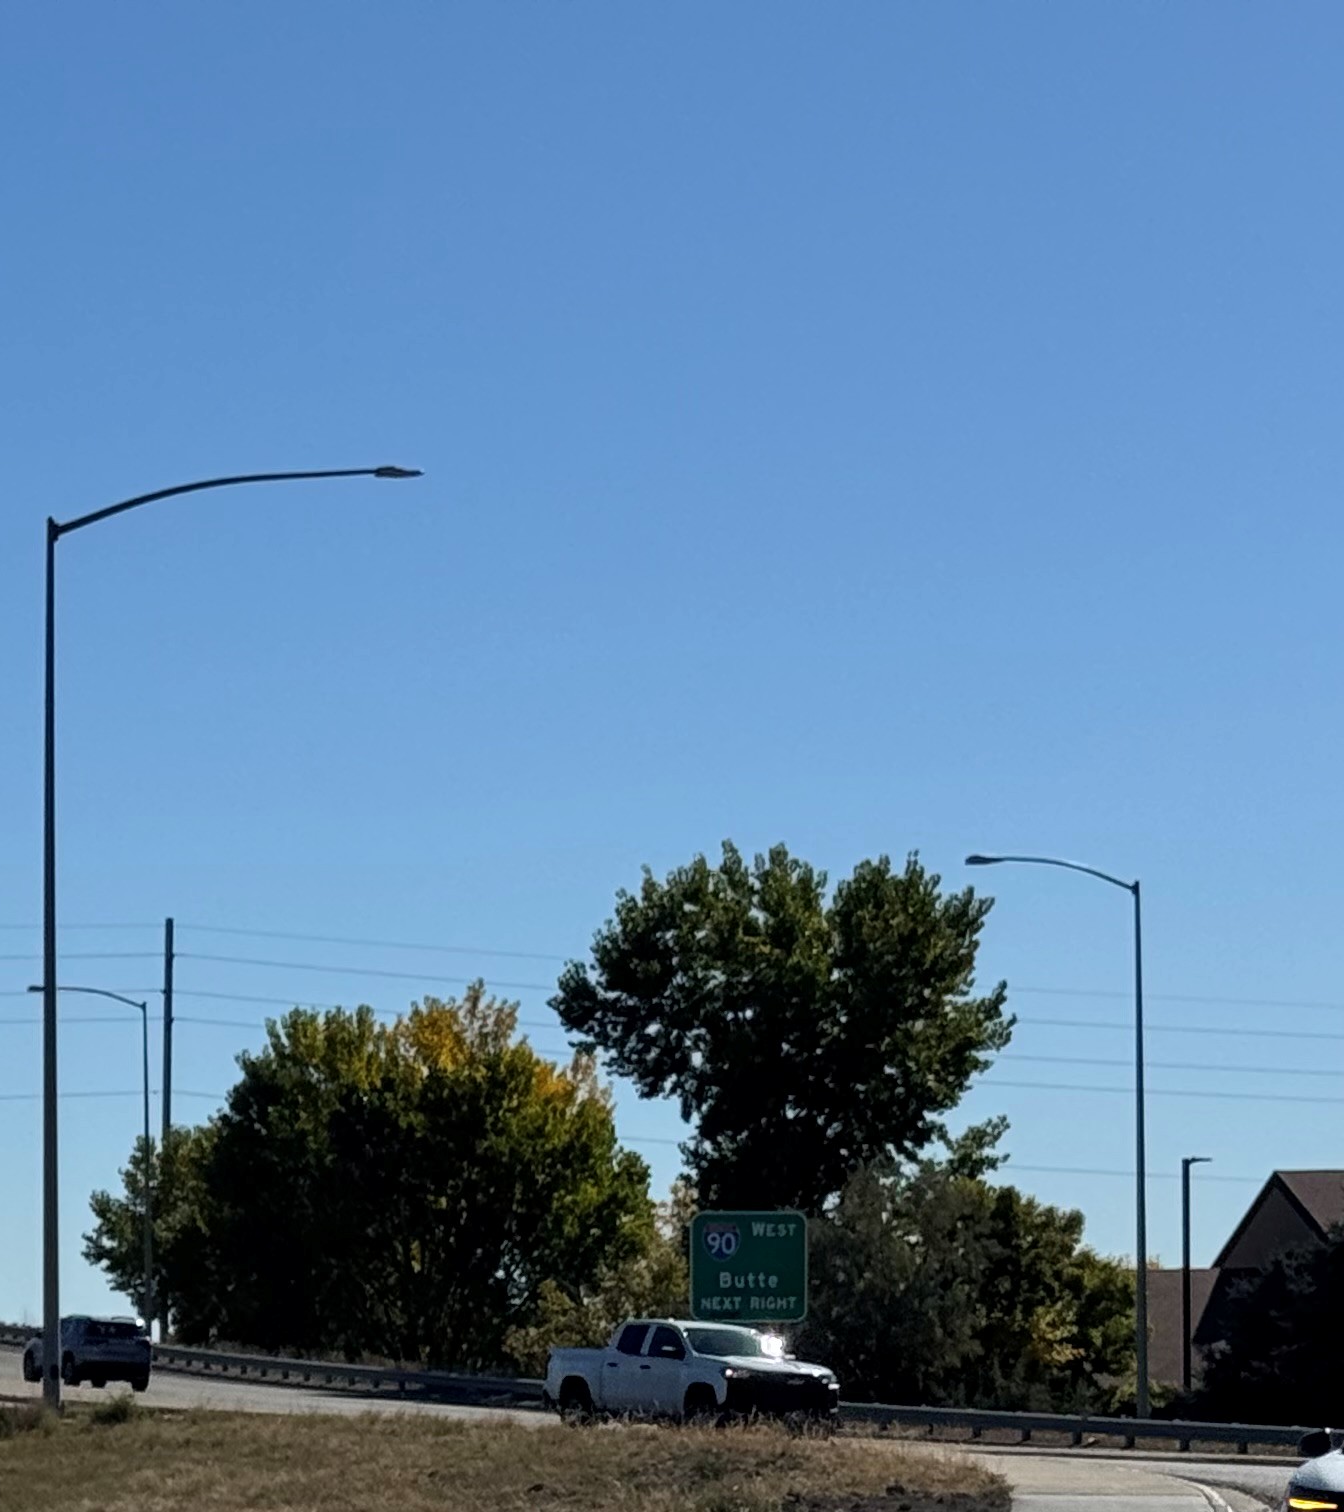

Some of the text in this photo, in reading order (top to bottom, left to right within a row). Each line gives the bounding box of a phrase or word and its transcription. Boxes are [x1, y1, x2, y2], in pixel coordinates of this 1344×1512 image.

[751, 1221, 797, 1237] WEST
[706, 1232, 736, 1254] 90
[718, 1271, 779, 1288] Butte
[700, 1296, 797, 1310] NEXT RIGHT
